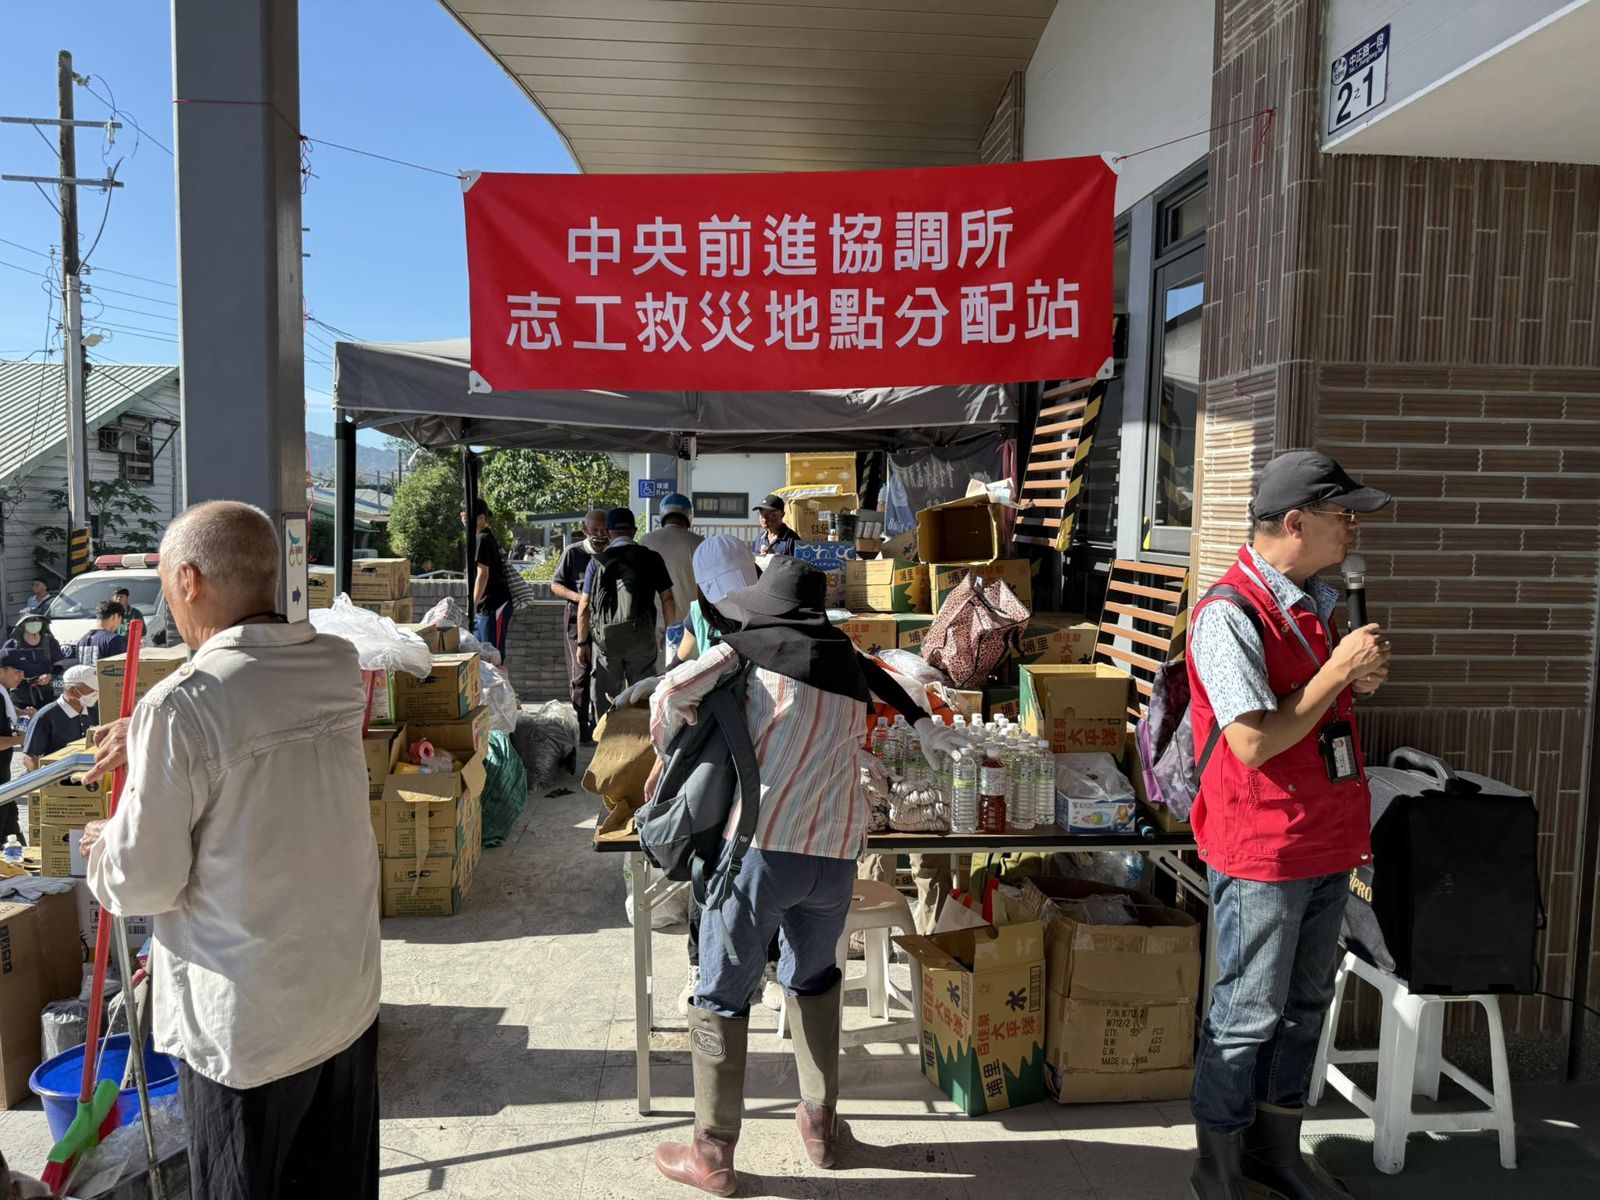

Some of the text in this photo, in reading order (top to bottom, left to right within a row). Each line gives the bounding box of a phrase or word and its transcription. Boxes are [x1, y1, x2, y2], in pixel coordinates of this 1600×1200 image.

[566, 206, 1014, 277] 中央前進協調所
[505, 277, 1080, 353] 志工救災地點分配站
[1005, 987, 1028, 1012] 水
[982, 1058, 1004, 1098] 埔里
[1101, 1056, 1120, 1066] MADE
